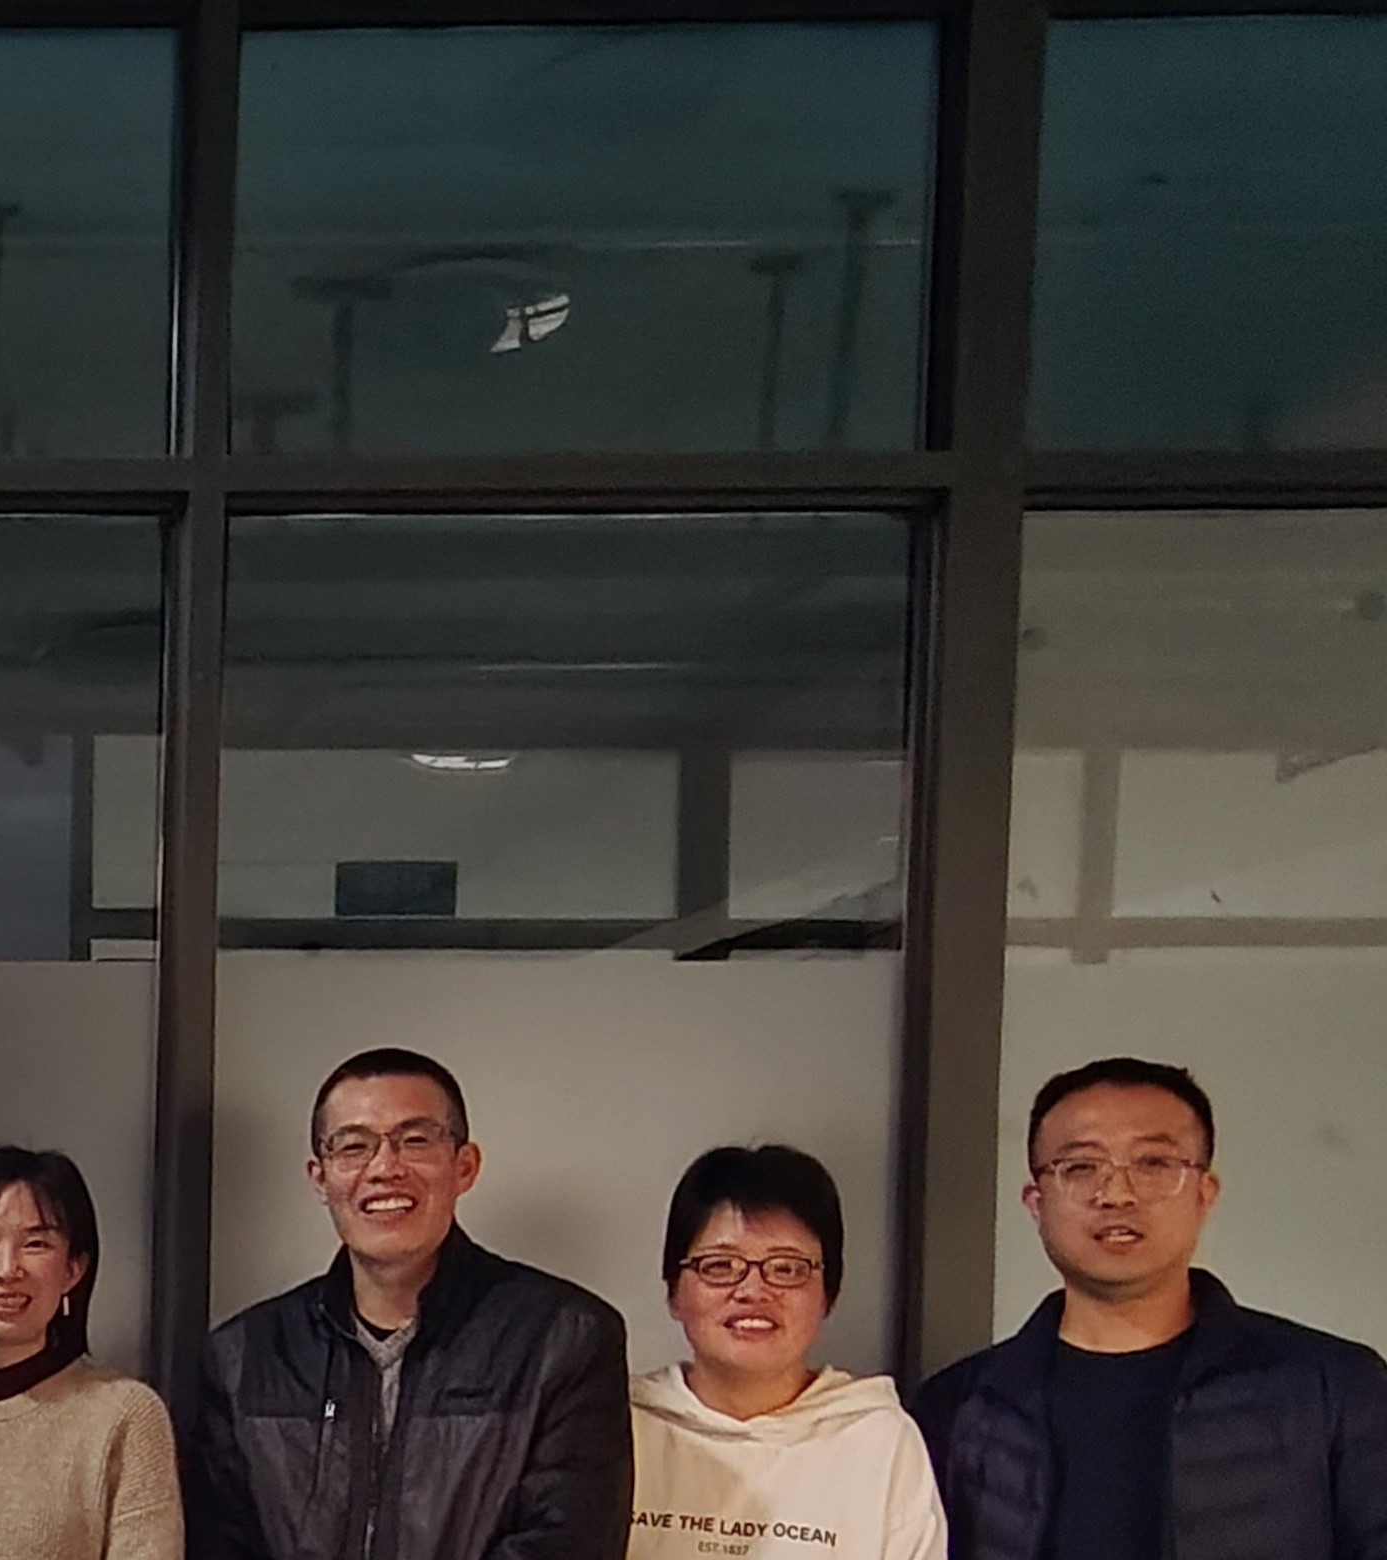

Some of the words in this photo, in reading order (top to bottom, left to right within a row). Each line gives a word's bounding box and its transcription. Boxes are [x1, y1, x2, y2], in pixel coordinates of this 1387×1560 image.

[679, 1514, 715, 1533] THE
[719, 1520, 768, 1538] LADY
[773, 1522, 837, 1547] OCEAN
